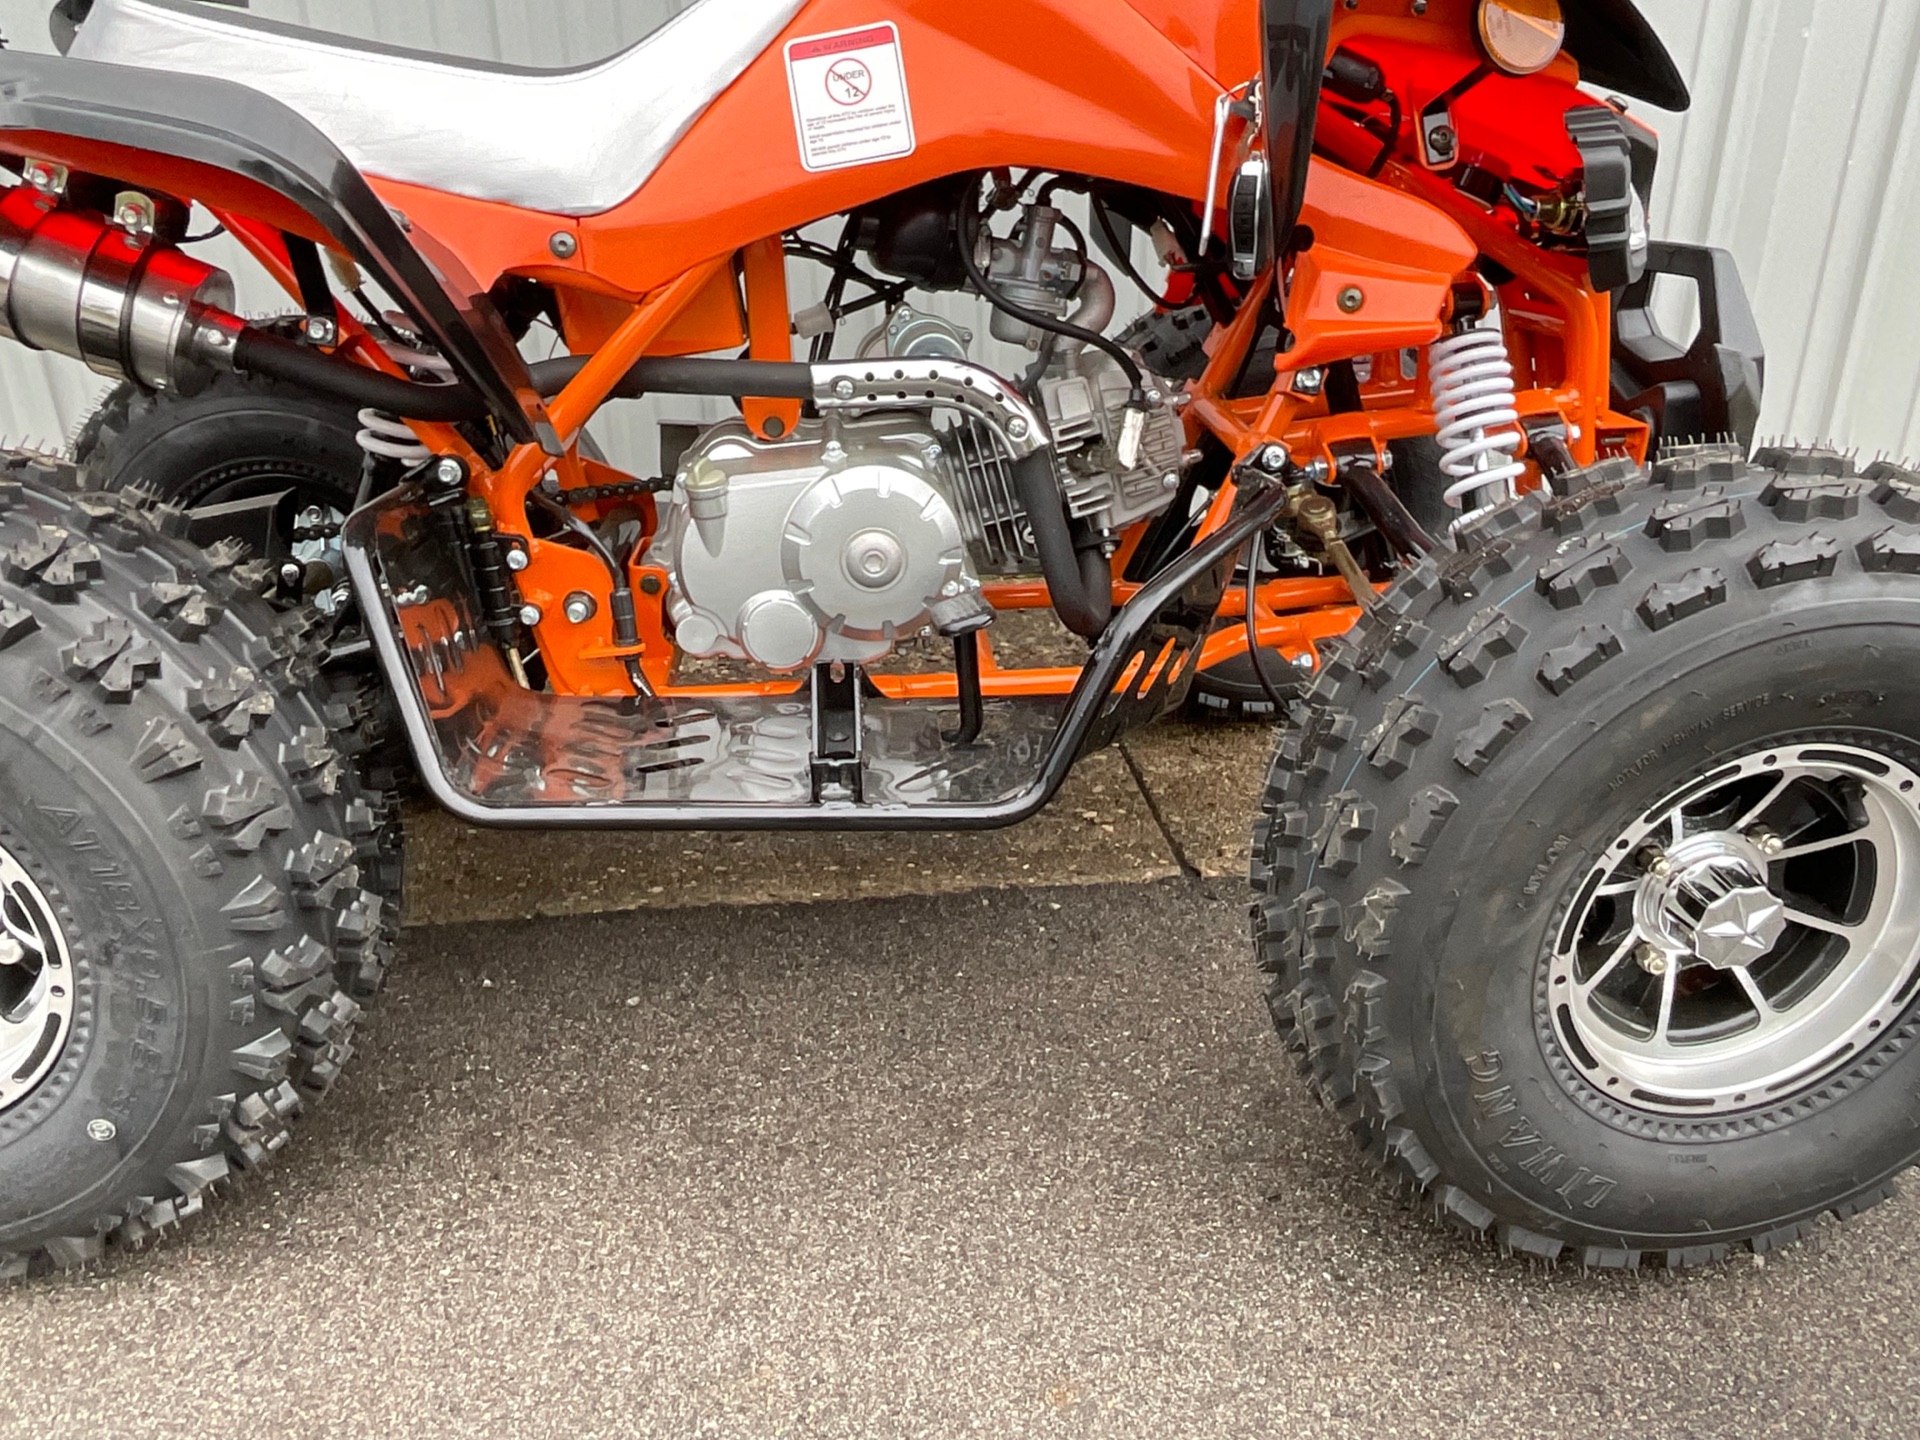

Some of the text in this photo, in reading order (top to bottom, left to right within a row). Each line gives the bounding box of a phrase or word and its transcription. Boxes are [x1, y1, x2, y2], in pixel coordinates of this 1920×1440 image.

[823, 35, 874, 50] WARNING
[832, 69, 865, 82] UNDER
[845, 86, 860, 98] 12
[1609, 693, 1770, 791] NOT FOR HIGHWAY SERVICE
[1465, 1050, 1618, 1208] LIWANG
